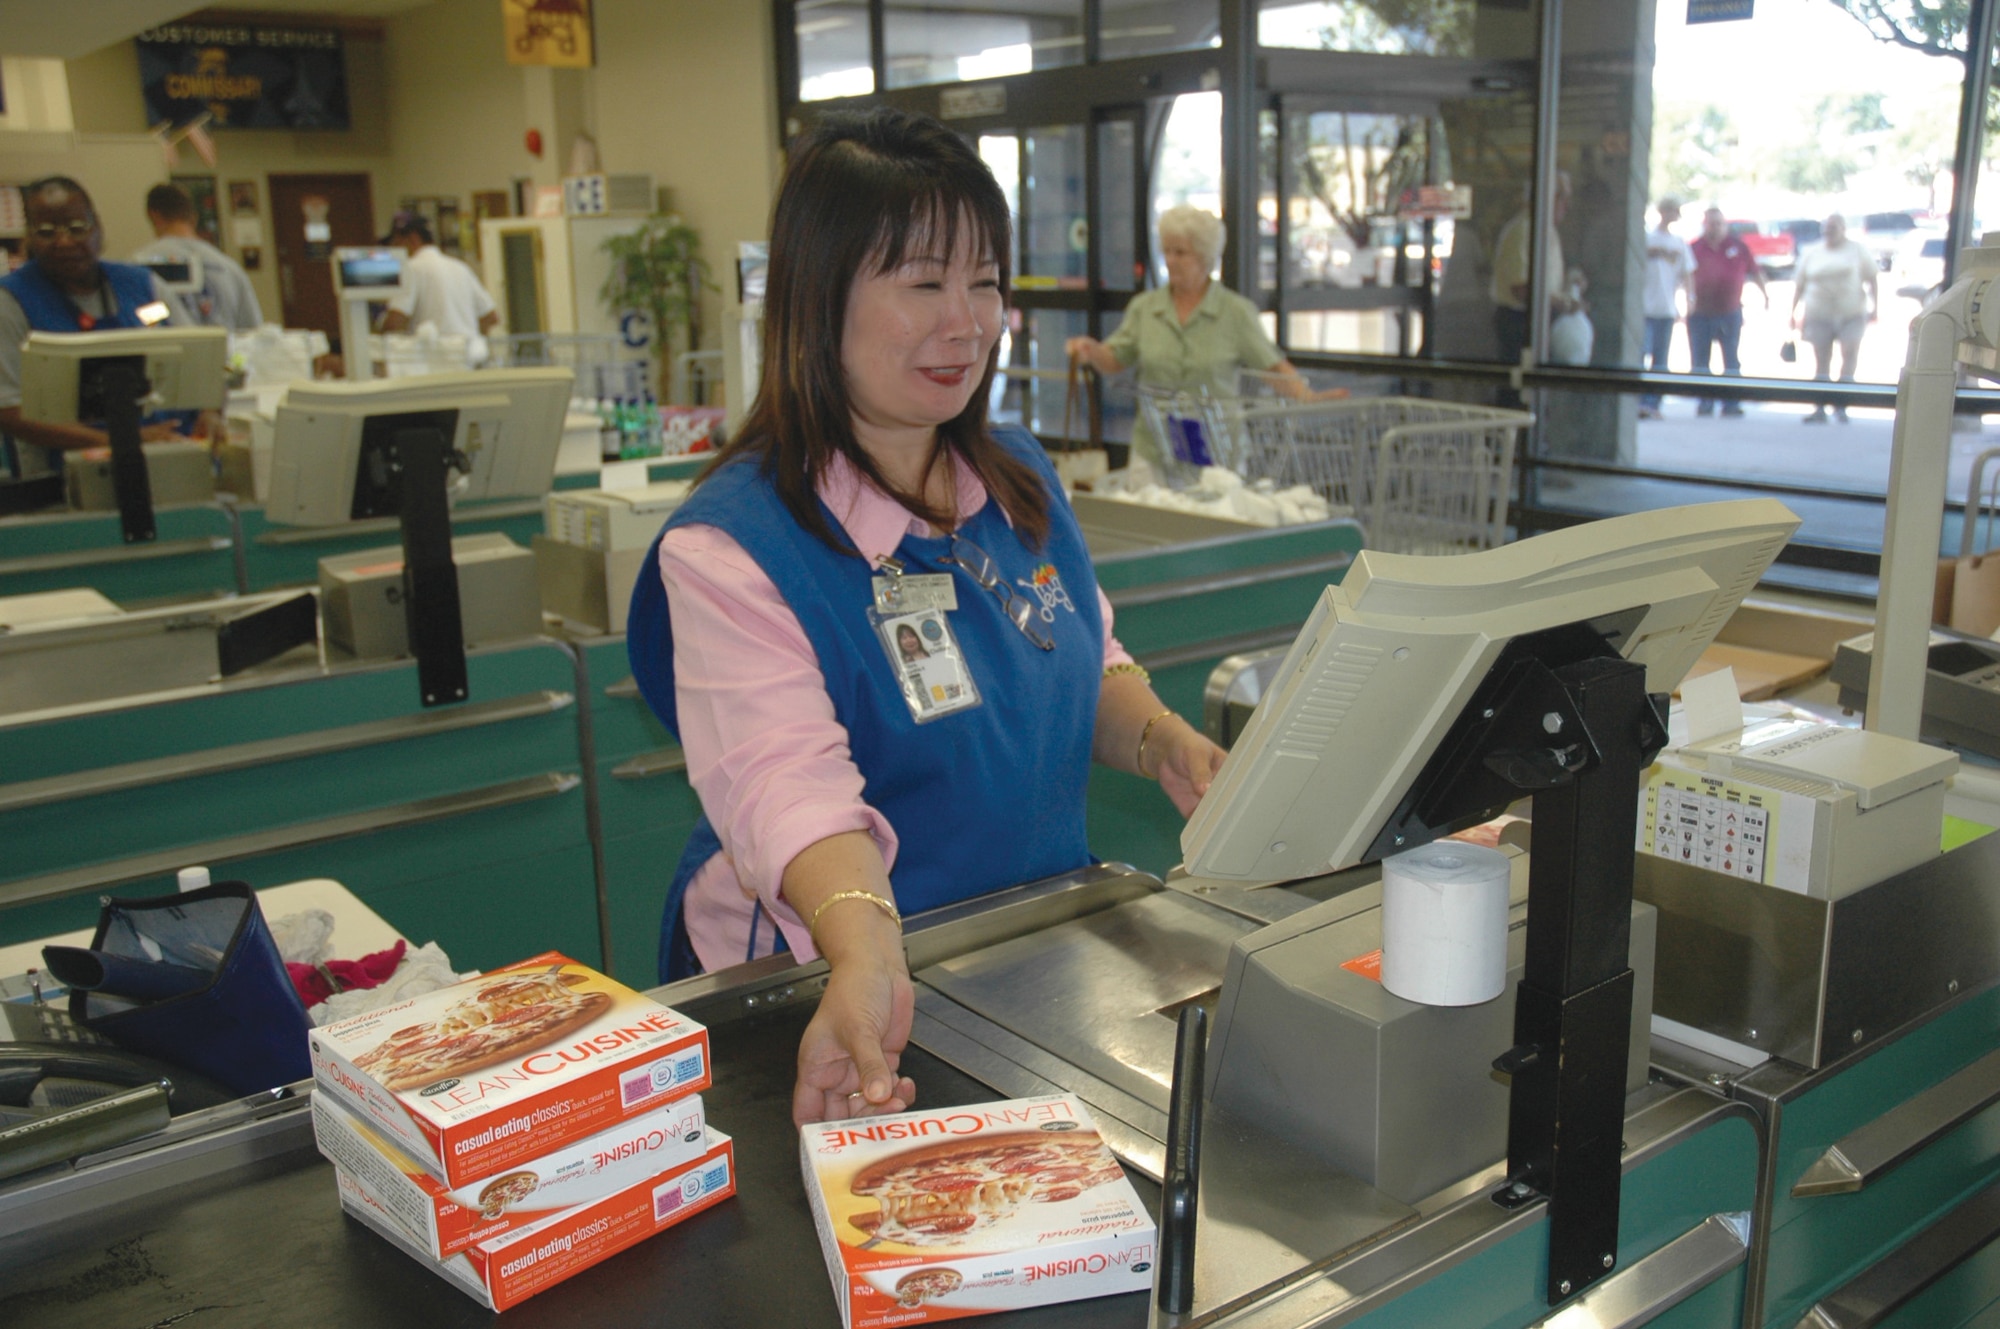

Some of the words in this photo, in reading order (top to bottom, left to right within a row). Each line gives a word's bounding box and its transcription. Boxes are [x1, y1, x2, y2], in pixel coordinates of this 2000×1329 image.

[320, 1000, 416, 1033] Traditional
[455, 1126, 494, 1156] casual
[495, 1115, 531, 1140] eating
[1037, 1217, 1146, 1244] Traditional
[501, 1249, 537, 1278] casual
[538, 1235, 572, 1260] eating
